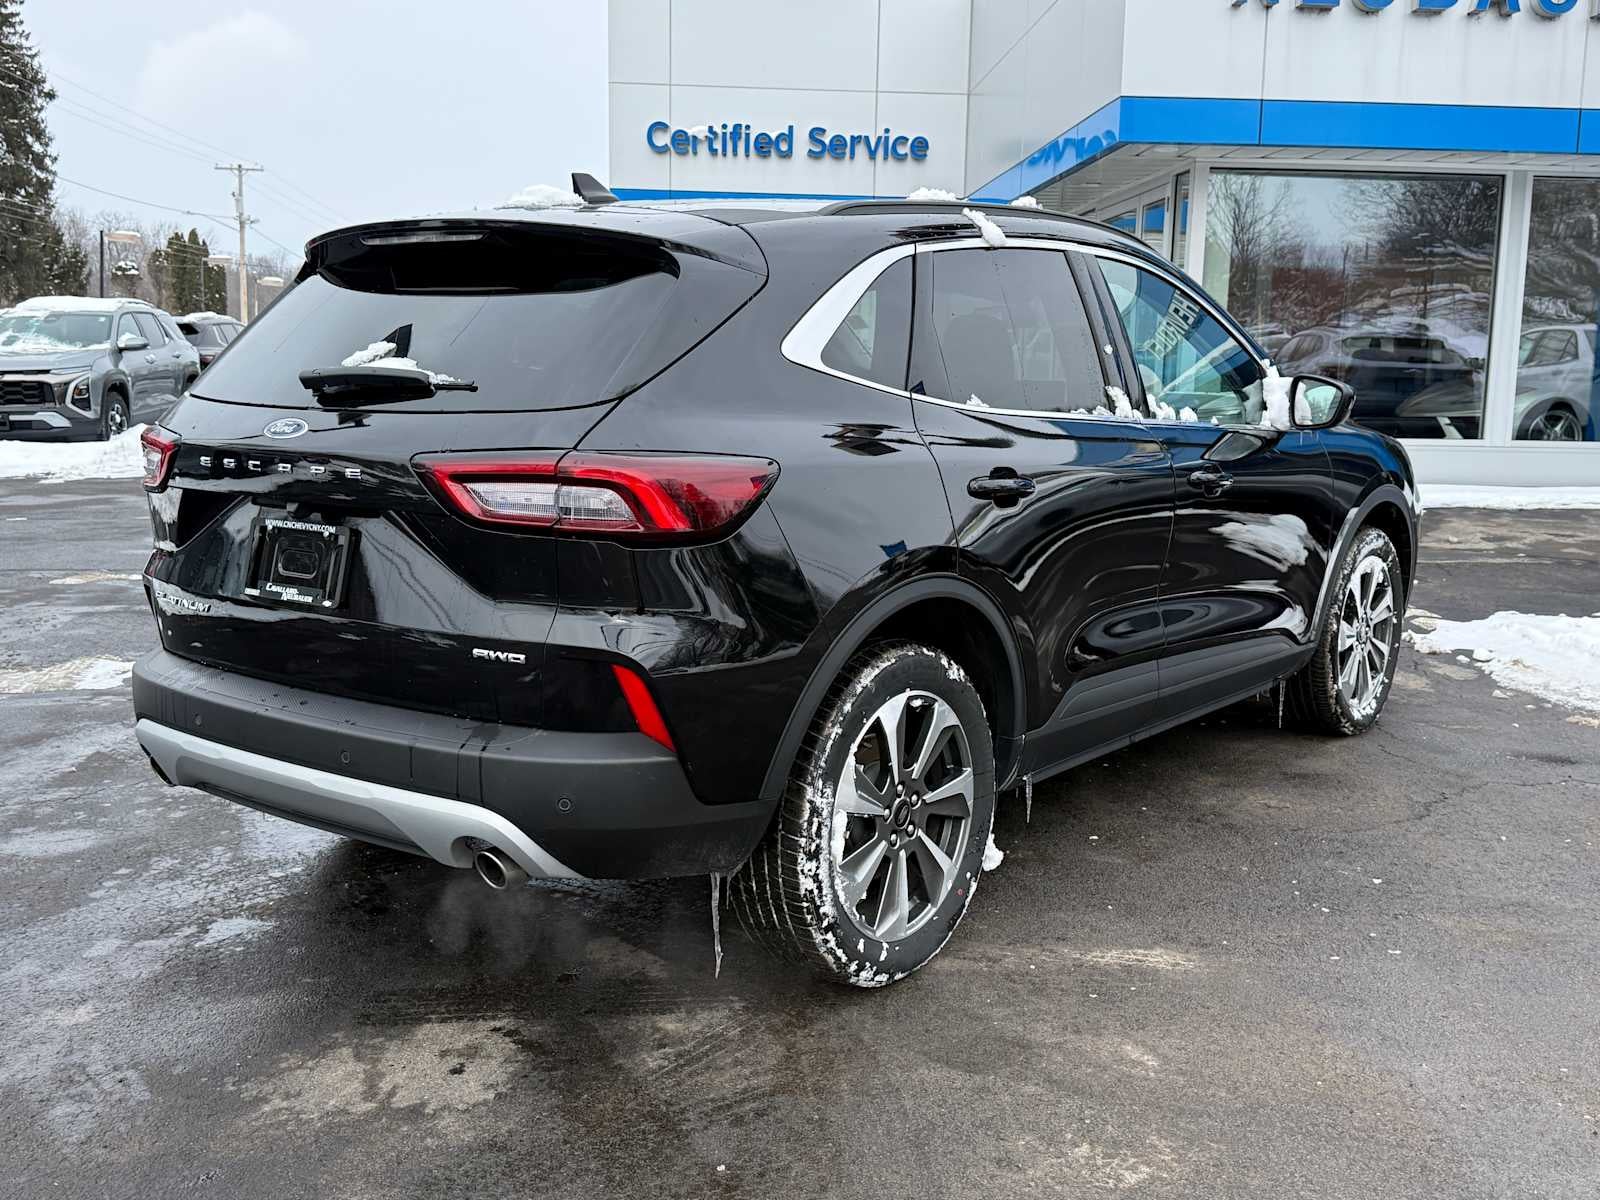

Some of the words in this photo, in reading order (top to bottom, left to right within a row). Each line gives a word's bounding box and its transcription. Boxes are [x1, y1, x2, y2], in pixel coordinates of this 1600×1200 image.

[646, 121, 794, 158] Certified
[807, 126, 930, 161] Service
[199, 455, 362, 480] ESCAPE
[156, 590, 211, 613] PLATINUM
[472, 648, 526, 665] AWD
